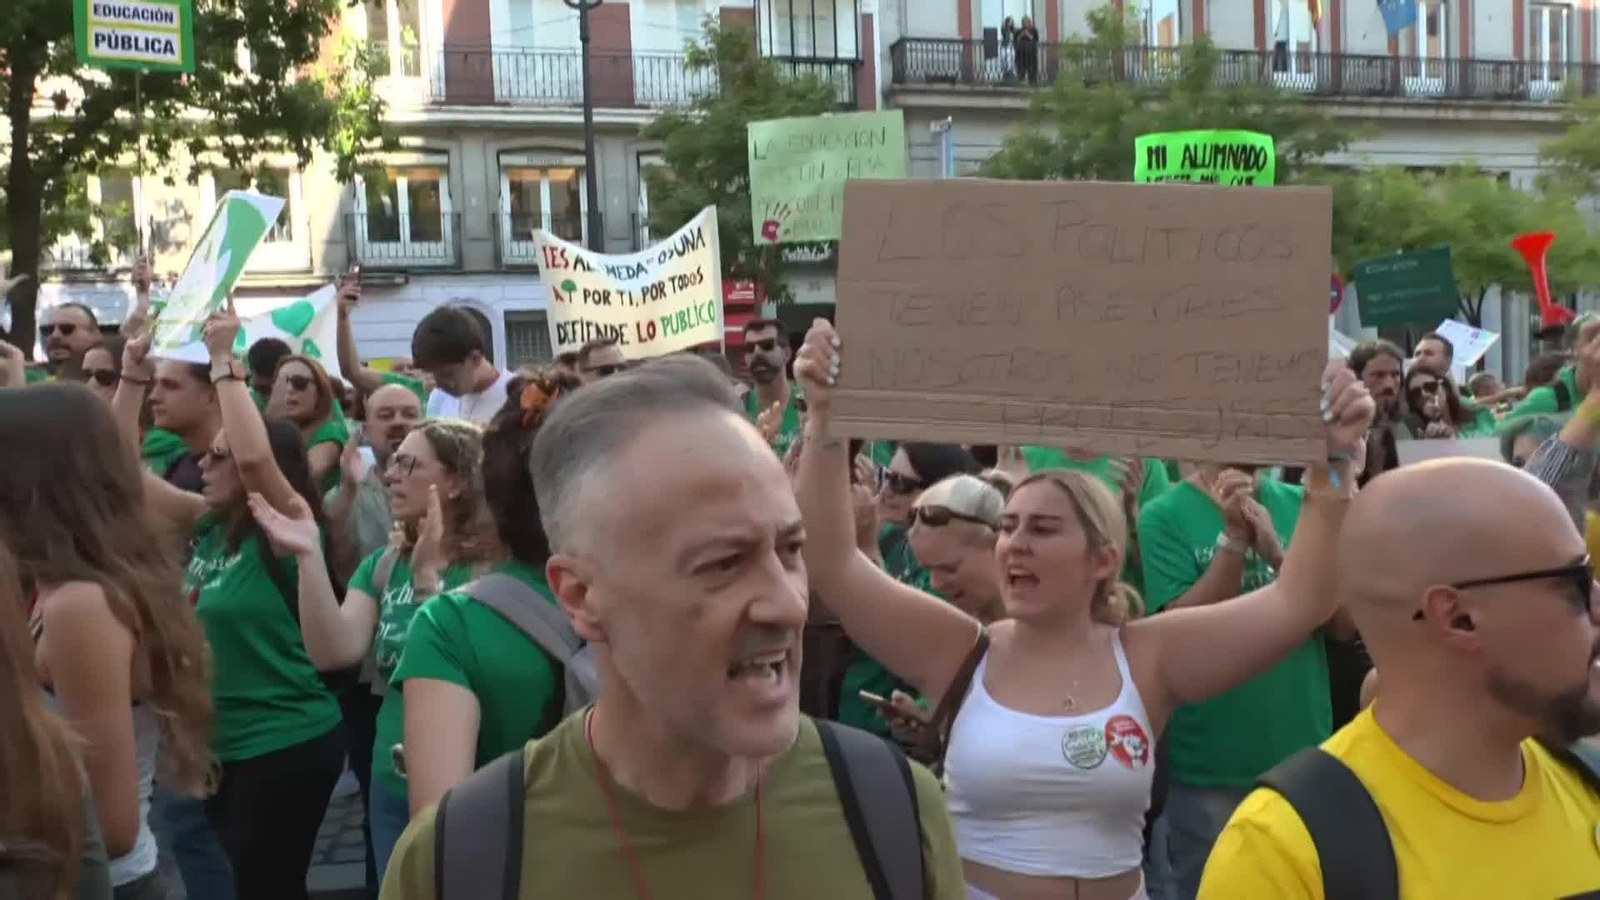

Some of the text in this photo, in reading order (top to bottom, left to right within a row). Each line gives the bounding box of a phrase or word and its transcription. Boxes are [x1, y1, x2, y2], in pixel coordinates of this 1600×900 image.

[93, 3, 174, 24] EDUCACIÓN
[94, 29, 176, 56] PÚBLICA
[1146, 143, 1268, 172] MI ALUMNADO
[542, 246, 570, 270] IES
[572, 254, 648, 281] ALMEDA
[583, 288, 612, 306] POR
[641, 280, 667, 303] POR
[636, 319, 657, 344] LO
